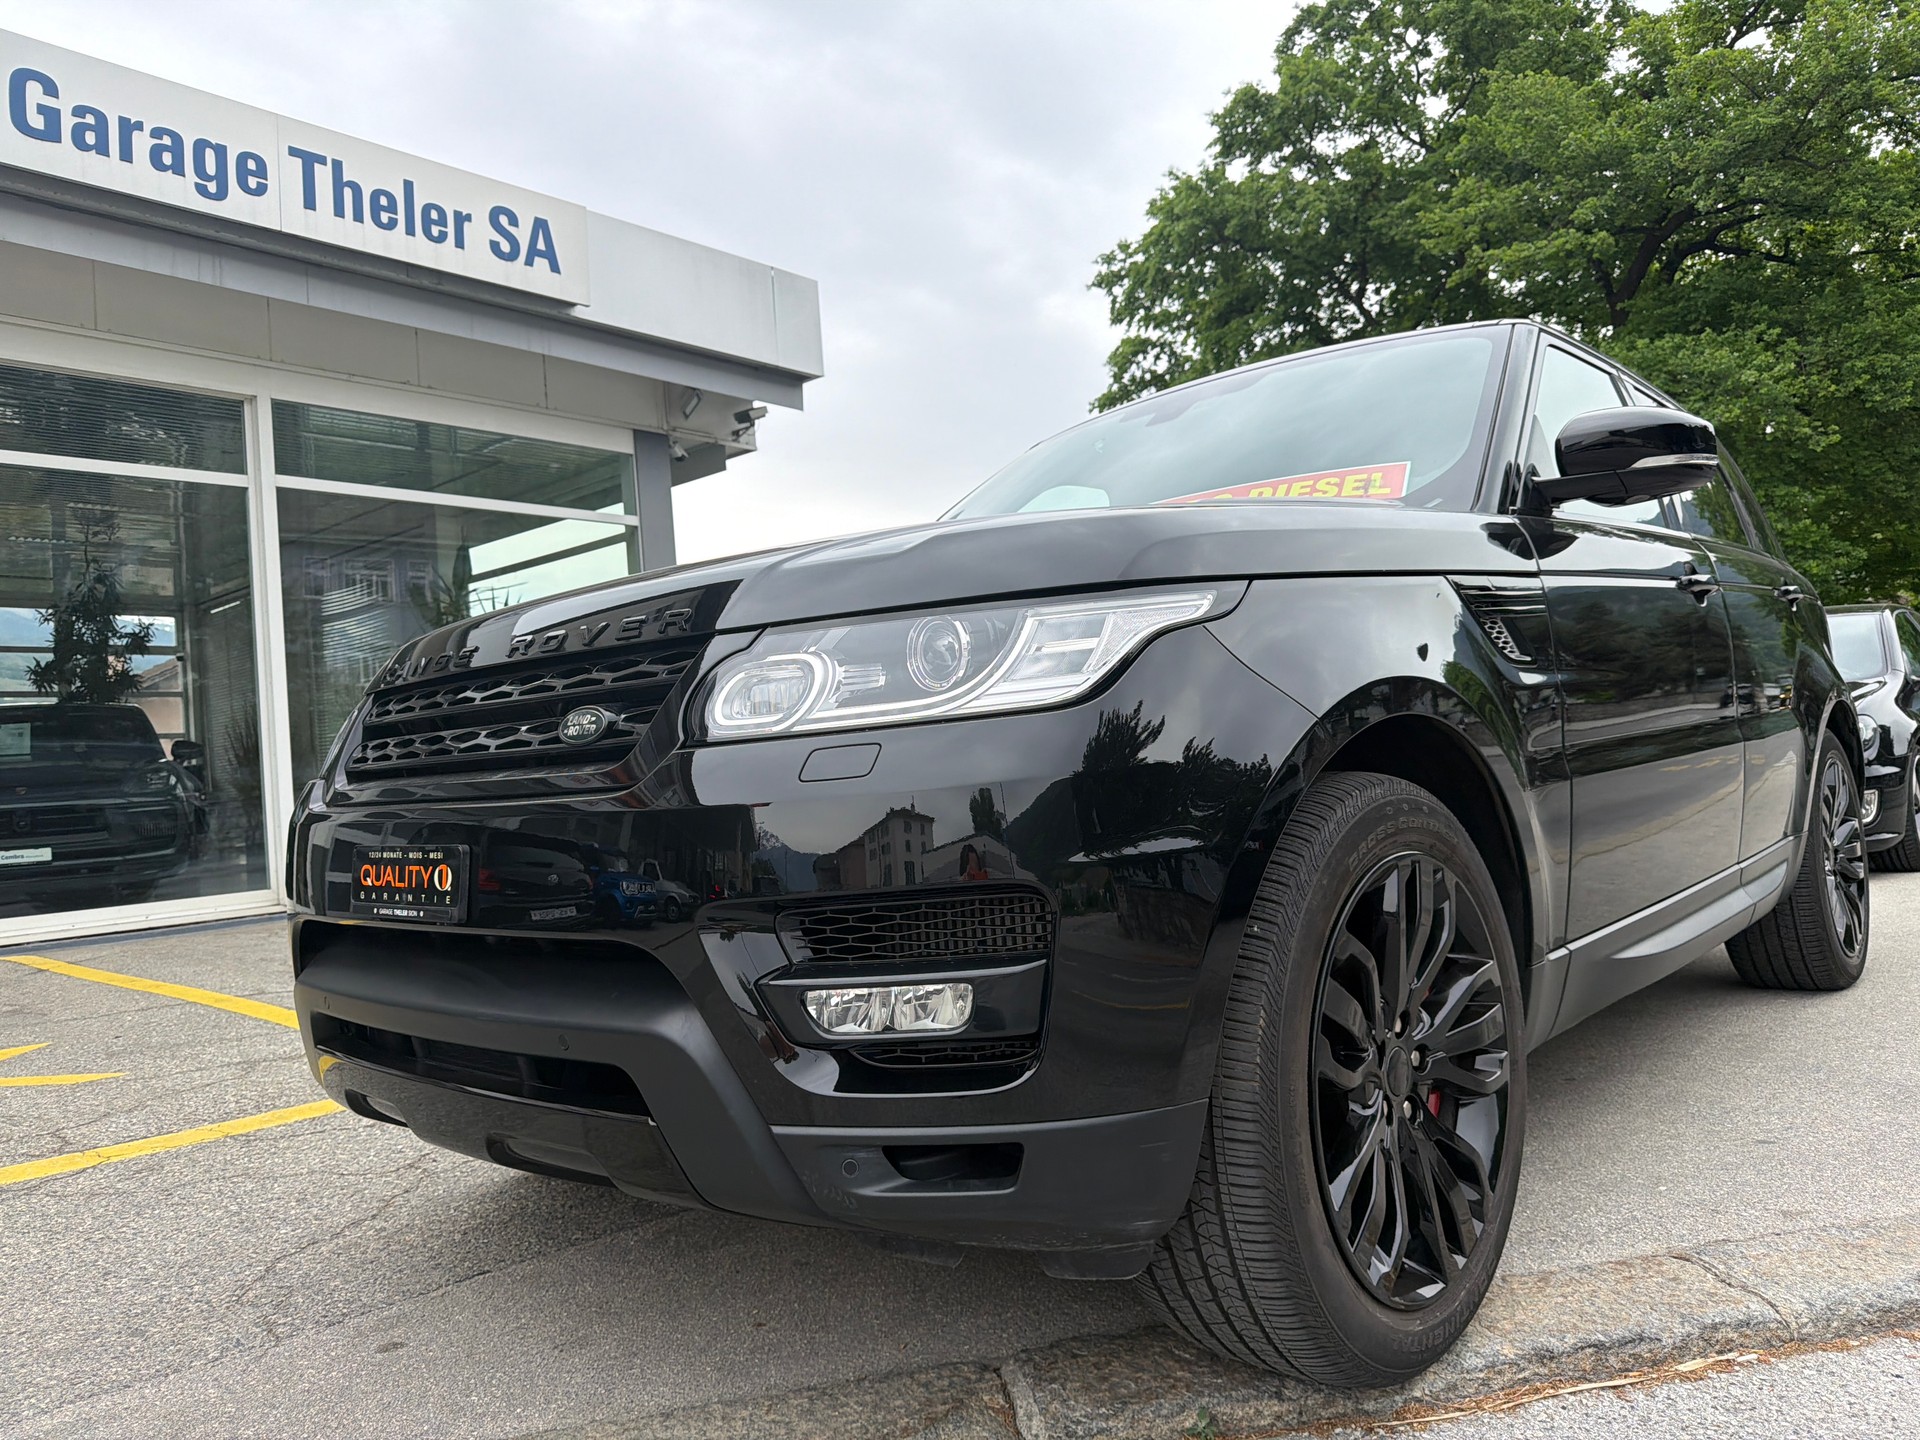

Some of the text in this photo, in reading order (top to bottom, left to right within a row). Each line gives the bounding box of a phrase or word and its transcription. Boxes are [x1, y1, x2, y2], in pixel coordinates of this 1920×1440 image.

[9, 66, 562, 275] Garage Theler SA
[506, 608, 692, 658] ROVER
[567, 715, 591, 726] LAND
[567, 724, 597, 736] ROVER
[382, 851, 403, 859] MONATE
[360, 864, 433, 889] QUALITY
[360, 891, 451, 904] GARANTIE
